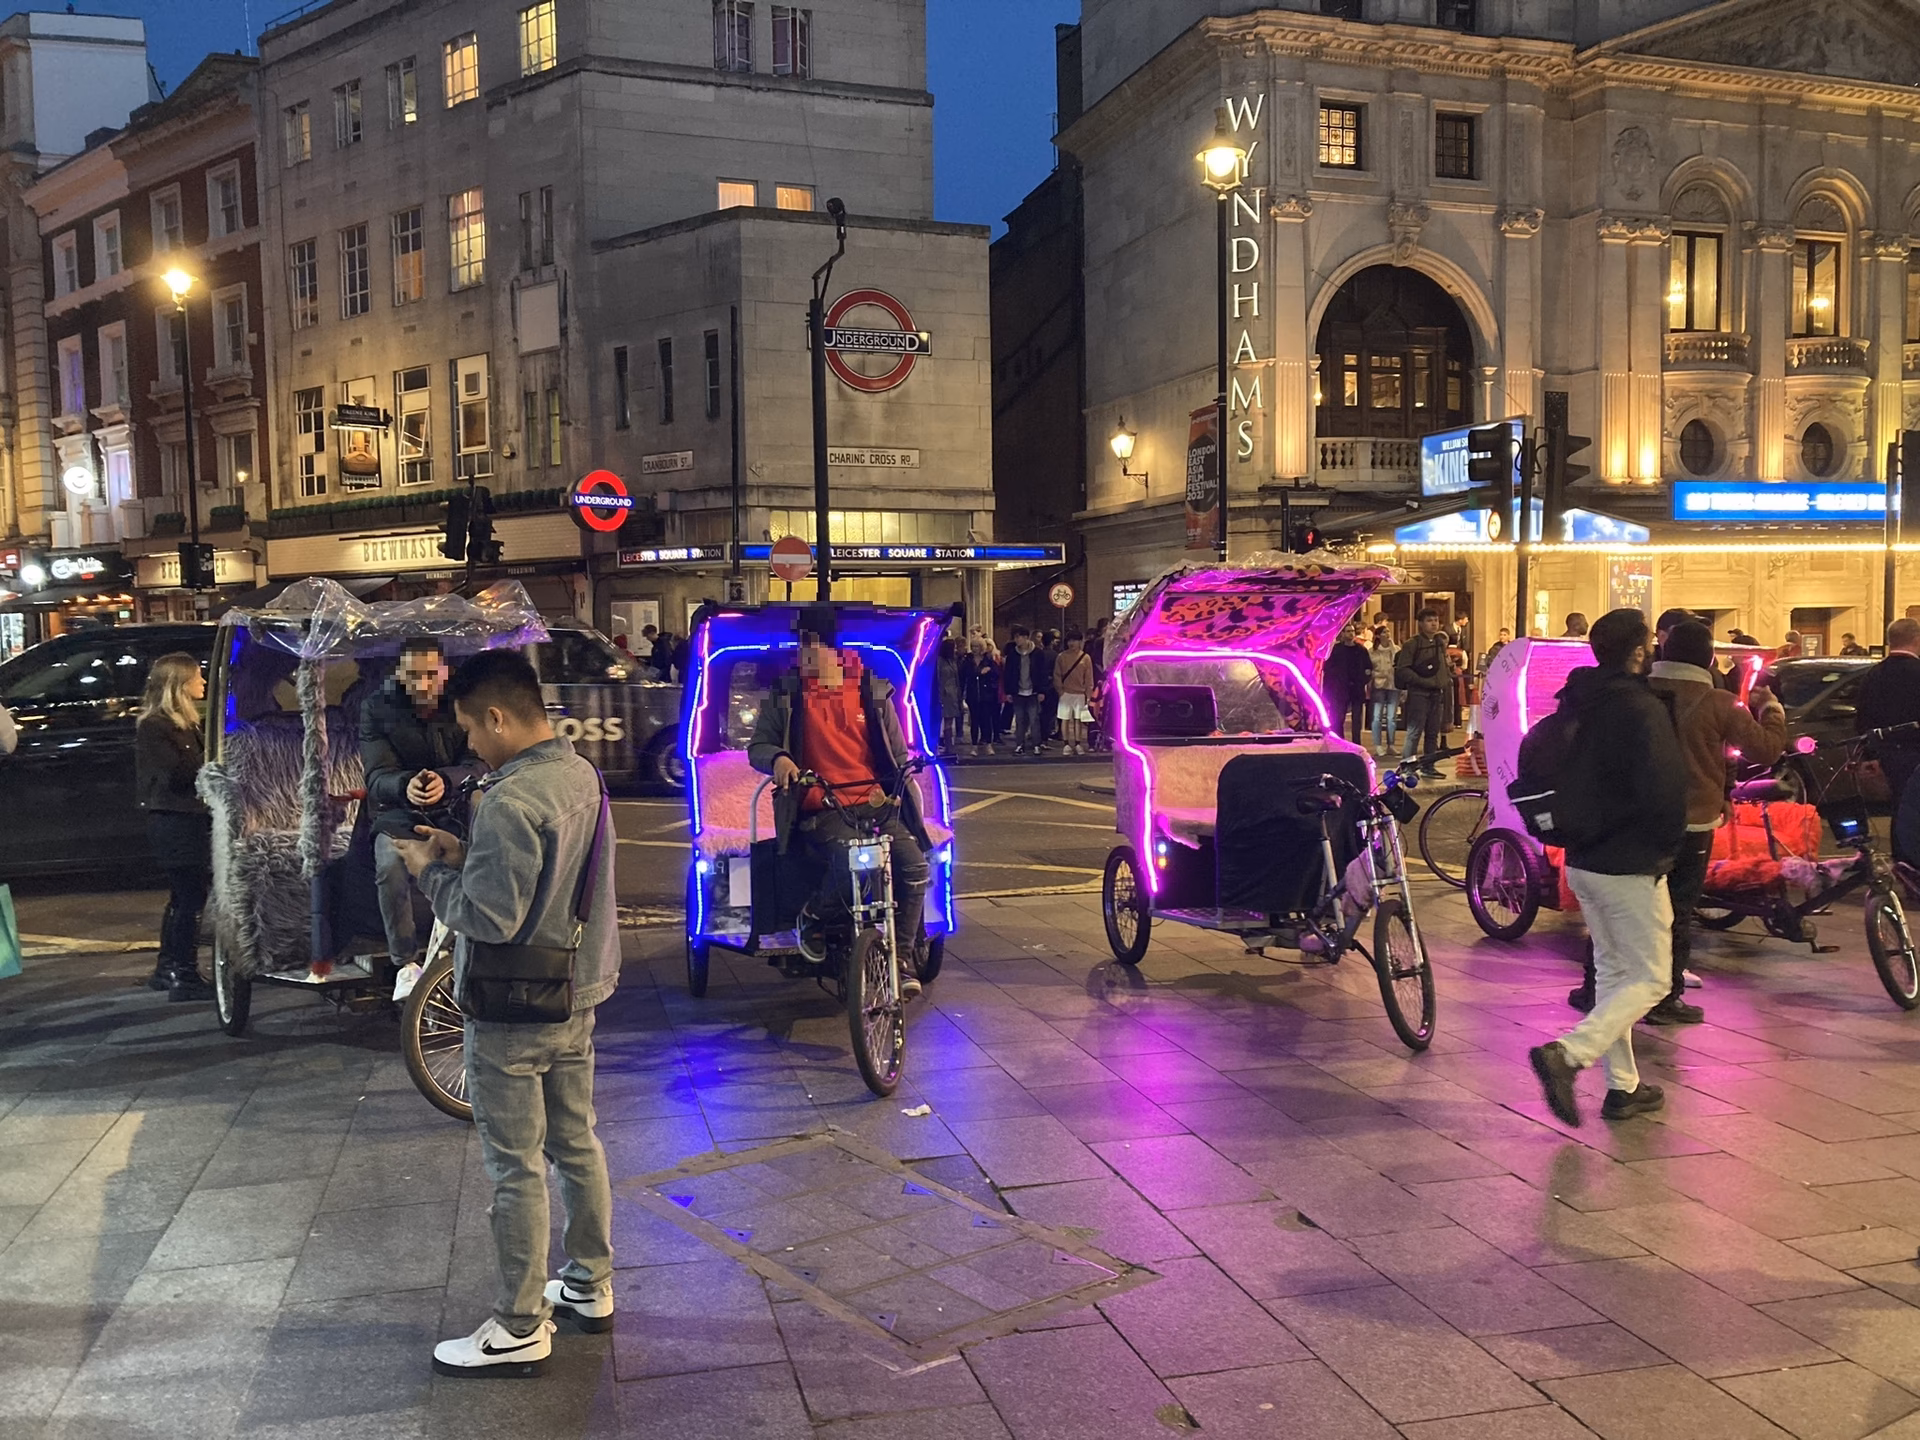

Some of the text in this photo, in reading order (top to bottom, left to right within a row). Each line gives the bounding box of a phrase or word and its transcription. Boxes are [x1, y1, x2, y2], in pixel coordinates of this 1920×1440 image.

[1226, 93, 1264, 458] WYNDHAMS
[824, 330, 919, 351] UNDERGROUND
[1188, 444, 1216, 458] LONDON
[643, 457, 679, 471] CRANBOURN
[829, 452, 865, 464] CHARING
[869, 454, 896, 465] CROSS
[1188, 455, 1205, 467] EAST
[1188, 464, 1204, 475] ASIA
[1434, 449, 1469, 486] KING
[1187, 473, 1204, 484] FILM
[1187, 479, 1217, 493] FESTIVAL
[574, 495, 632, 508] UNDERGROUND
[362, 536, 446, 563] BREWMASTE
[622, 547, 722, 564] LEICESTER SQUARE STATION
[831, 548, 975, 559] LEICESTER SQUARE STATION
[549, 717, 626, 742] OSS
